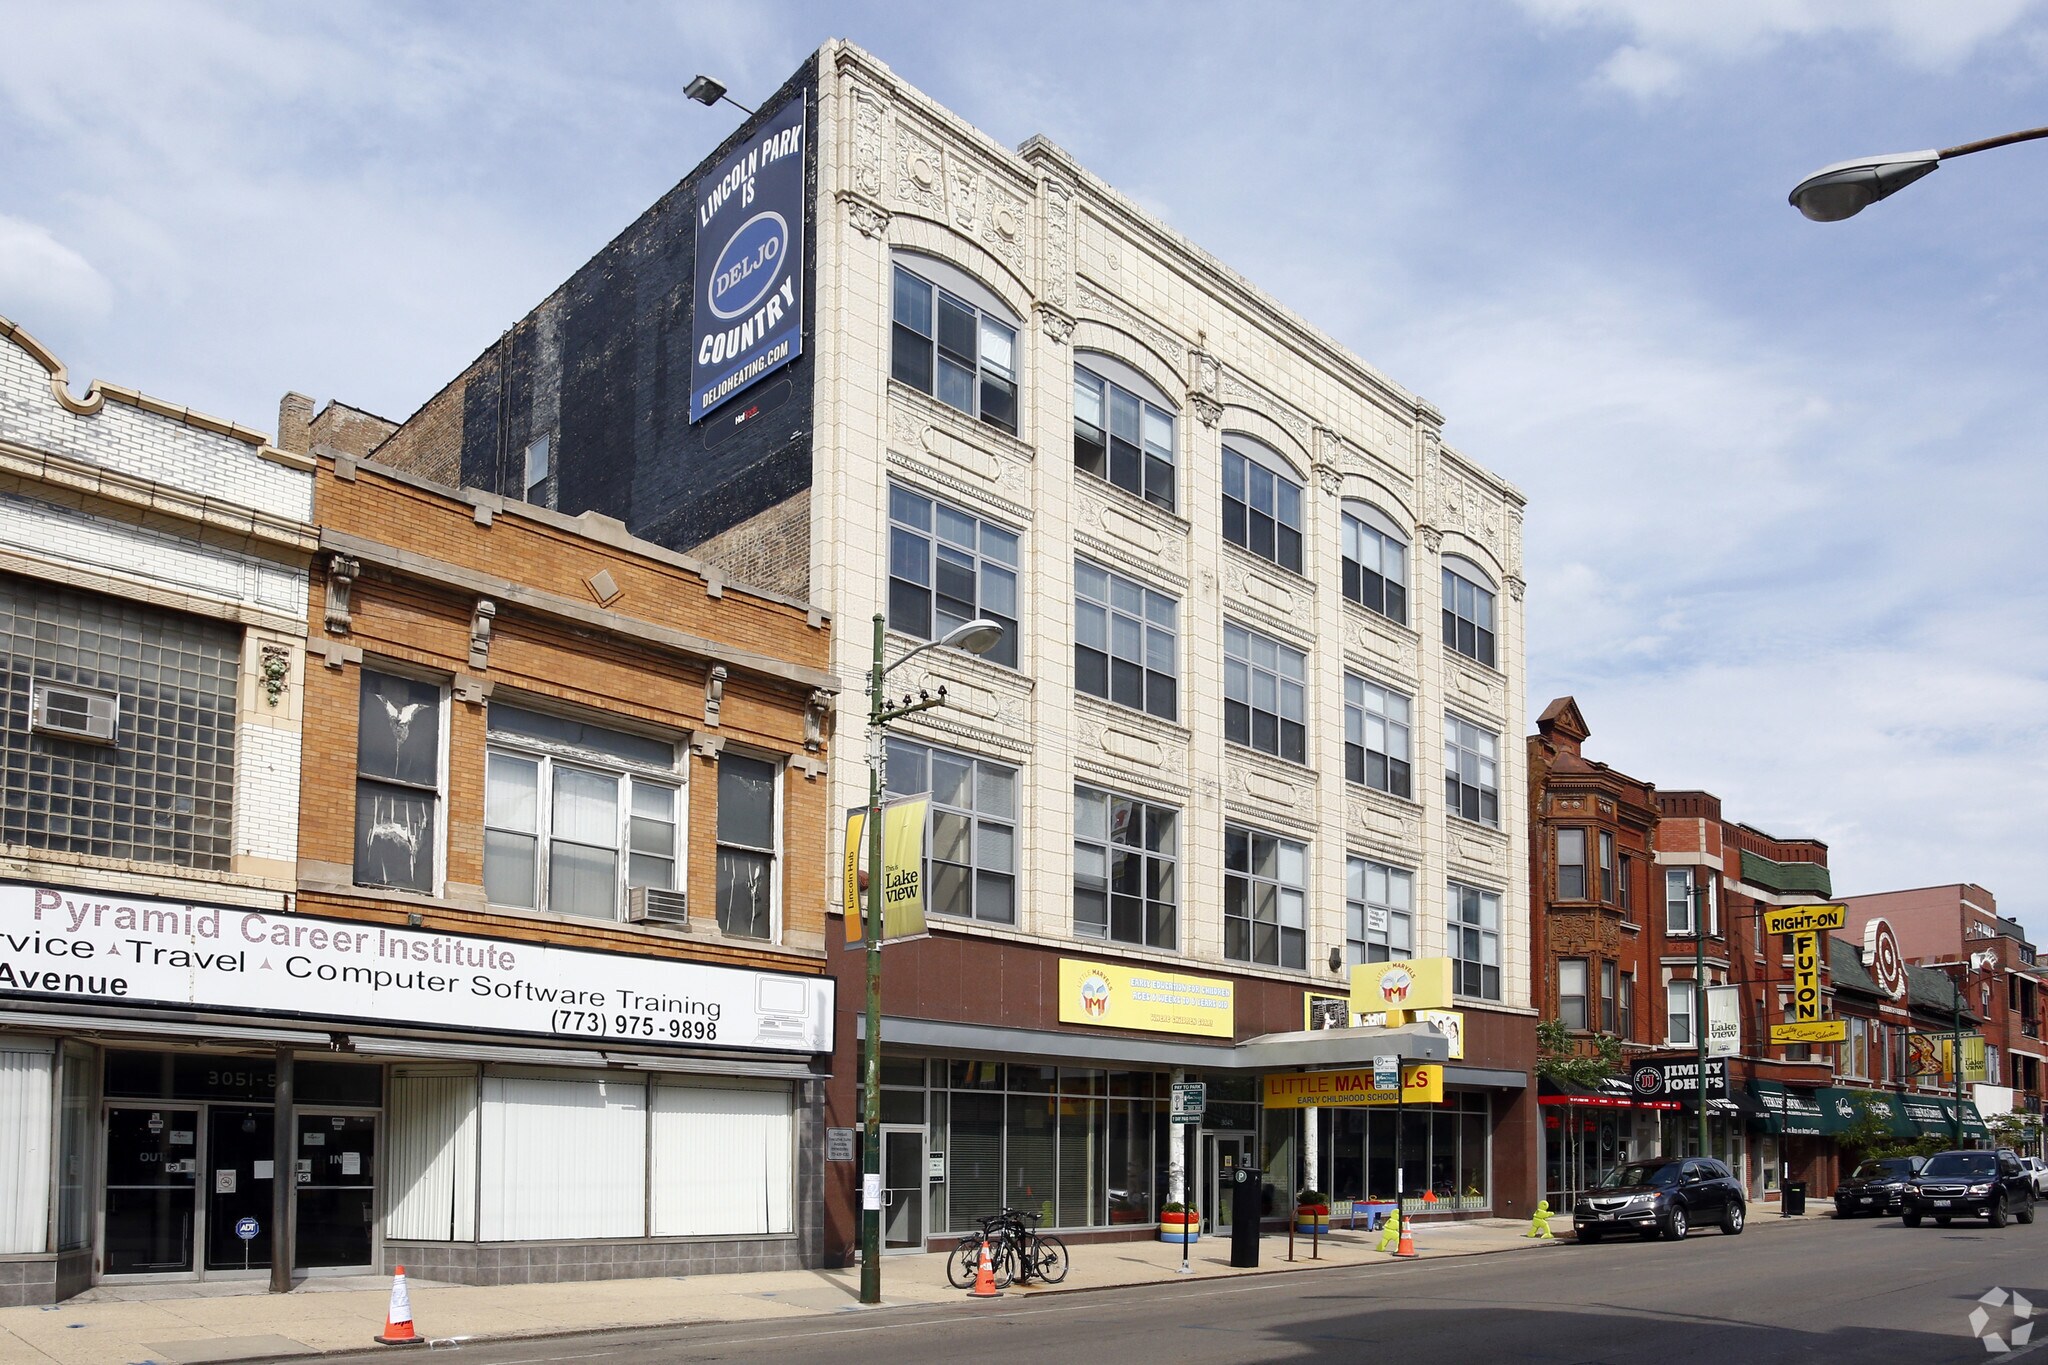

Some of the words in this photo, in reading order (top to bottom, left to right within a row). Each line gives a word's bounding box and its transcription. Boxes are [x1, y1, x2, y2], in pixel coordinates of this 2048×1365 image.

[700, 147, 758, 228] LINCOLN
[761, 124, 803, 167] PARK
[741, 177, 755, 208] IS
[715, 235, 780, 298] DELJO
[698, 275, 796, 366] COUNTRY
[701, 340, 789, 409] DELJOHEATING.COM
[885, 869, 918, 889] Lake
[886, 885, 918, 903] view
[34, 889, 220, 939] Pyramid
[240, 912, 369, 953] Career
[378, 930, 516, 971] Institute
[1772, 913, 1838, 931] RIGHT-ON
[0, 962, 128, 996] Avenue
[125, 939, 245, 973] Travel
[286, 956, 459, 993] Computer
[470, 974, 606, 1008] Software
[616, 989, 722, 1021] Training
[1092, 969, 1113, 991] MARVELS
[1392, 962, 1416, 979] MARVELS
[1797, 936, 1816, 1018] FUTON
[551, 1008, 607, 1037] (773)
[1711, 1022, 1737, 1031] Lake
[1776, 1026, 1797, 1035] Quality
[1796, 1030, 1816, 1038] Service
[1815, 1031, 1840, 1040] Selection
[1271, 1077, 1329, 1095] LITTLE
[1335, 1071, 1428, 1092] MARLS
[1297, 1096, 1320, 1104] EARLY
[1322, 1094, 1365, 1103] CHILDHOOD
[1367, 1092, 1399, 1101] SCHOOL
[330, 1155, 343, 1164] IN
[240, 1223, 256, 1231] ADT
